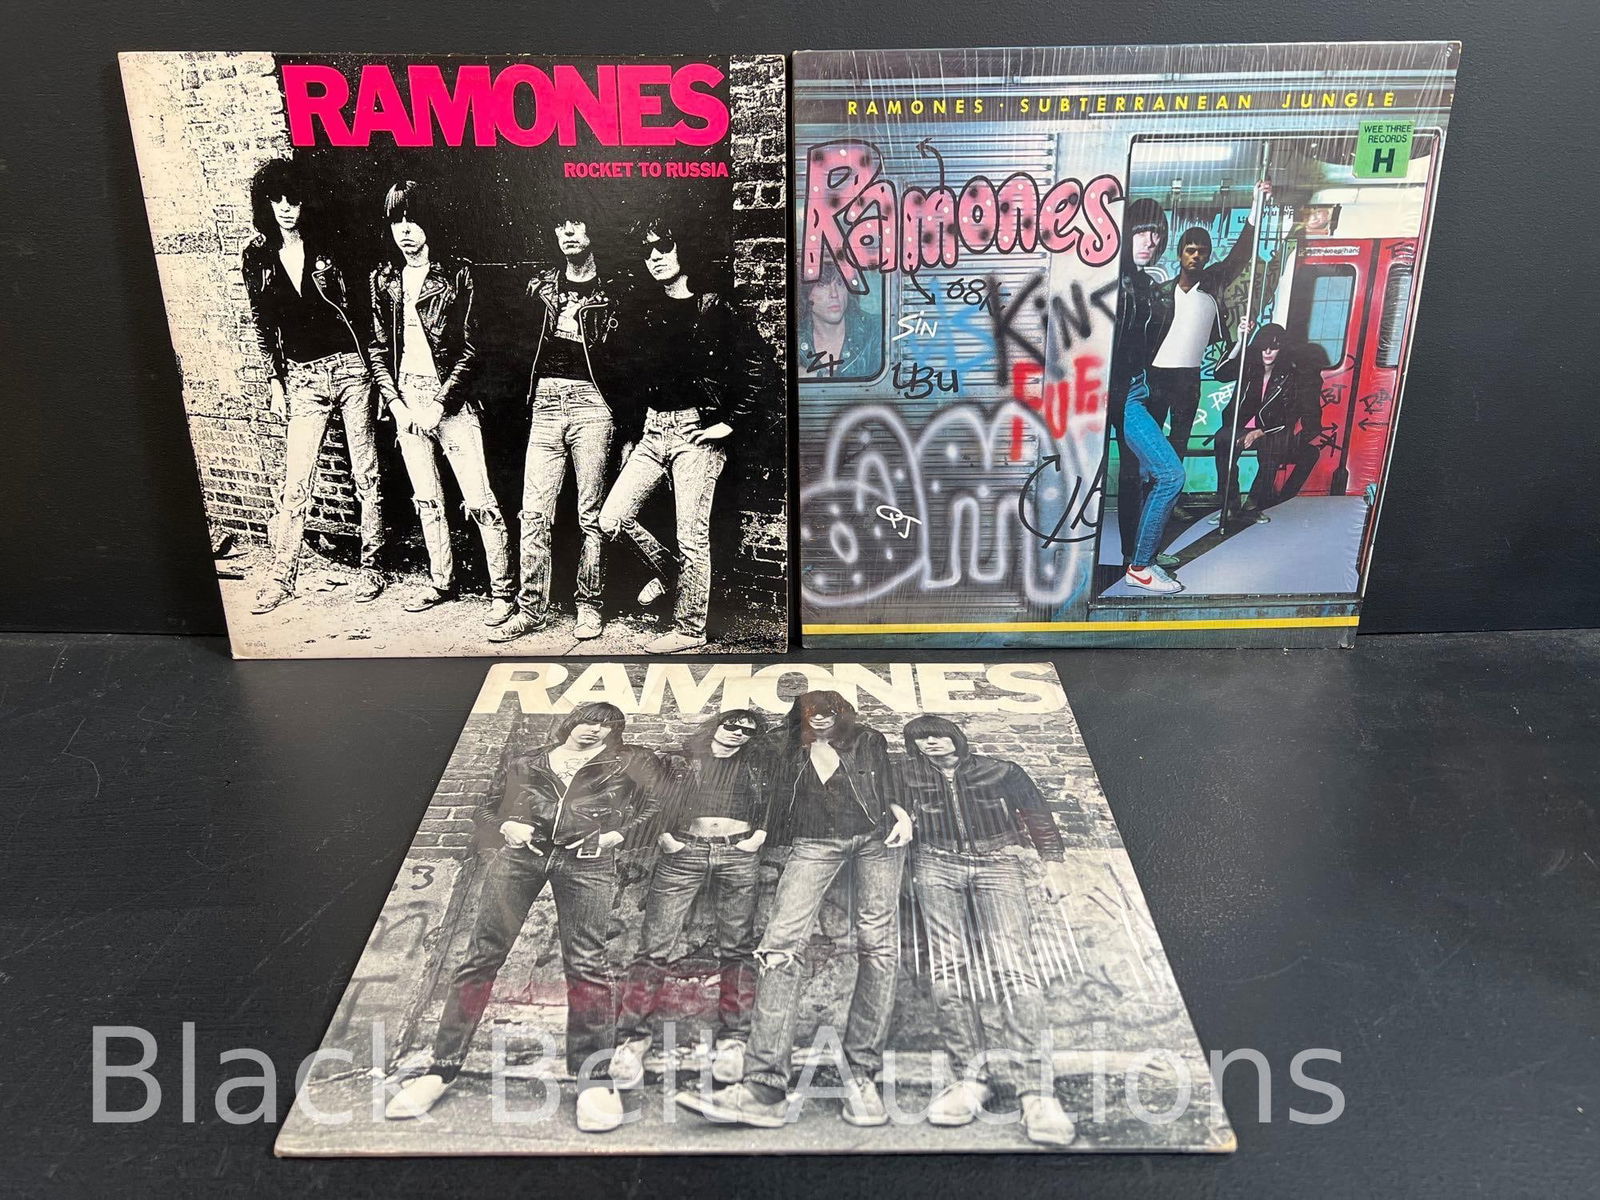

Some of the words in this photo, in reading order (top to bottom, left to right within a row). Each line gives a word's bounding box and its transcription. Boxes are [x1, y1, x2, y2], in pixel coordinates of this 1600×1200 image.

[281, 63, 730, 147] RAMONES
[847, 98, 983, 115] RAMONES
[1020, 94, 1252, 113] SUBTERRANEAN
[1282, 92, 1395, 108] JUNGLE
[1364, 124, 1383, 134] WEE
[1386, 124, 1412, 133] THREE
[1368, 134, 1407, 144] RECORDS
[563, 162, 634, 178] ROCKET
[639, 162, 662, 178] TO
[666, 162, 729, 178] RUSSIA
[1371, 148, 1396, 174] H
[472, 663, 1064, 715] RAMONES
